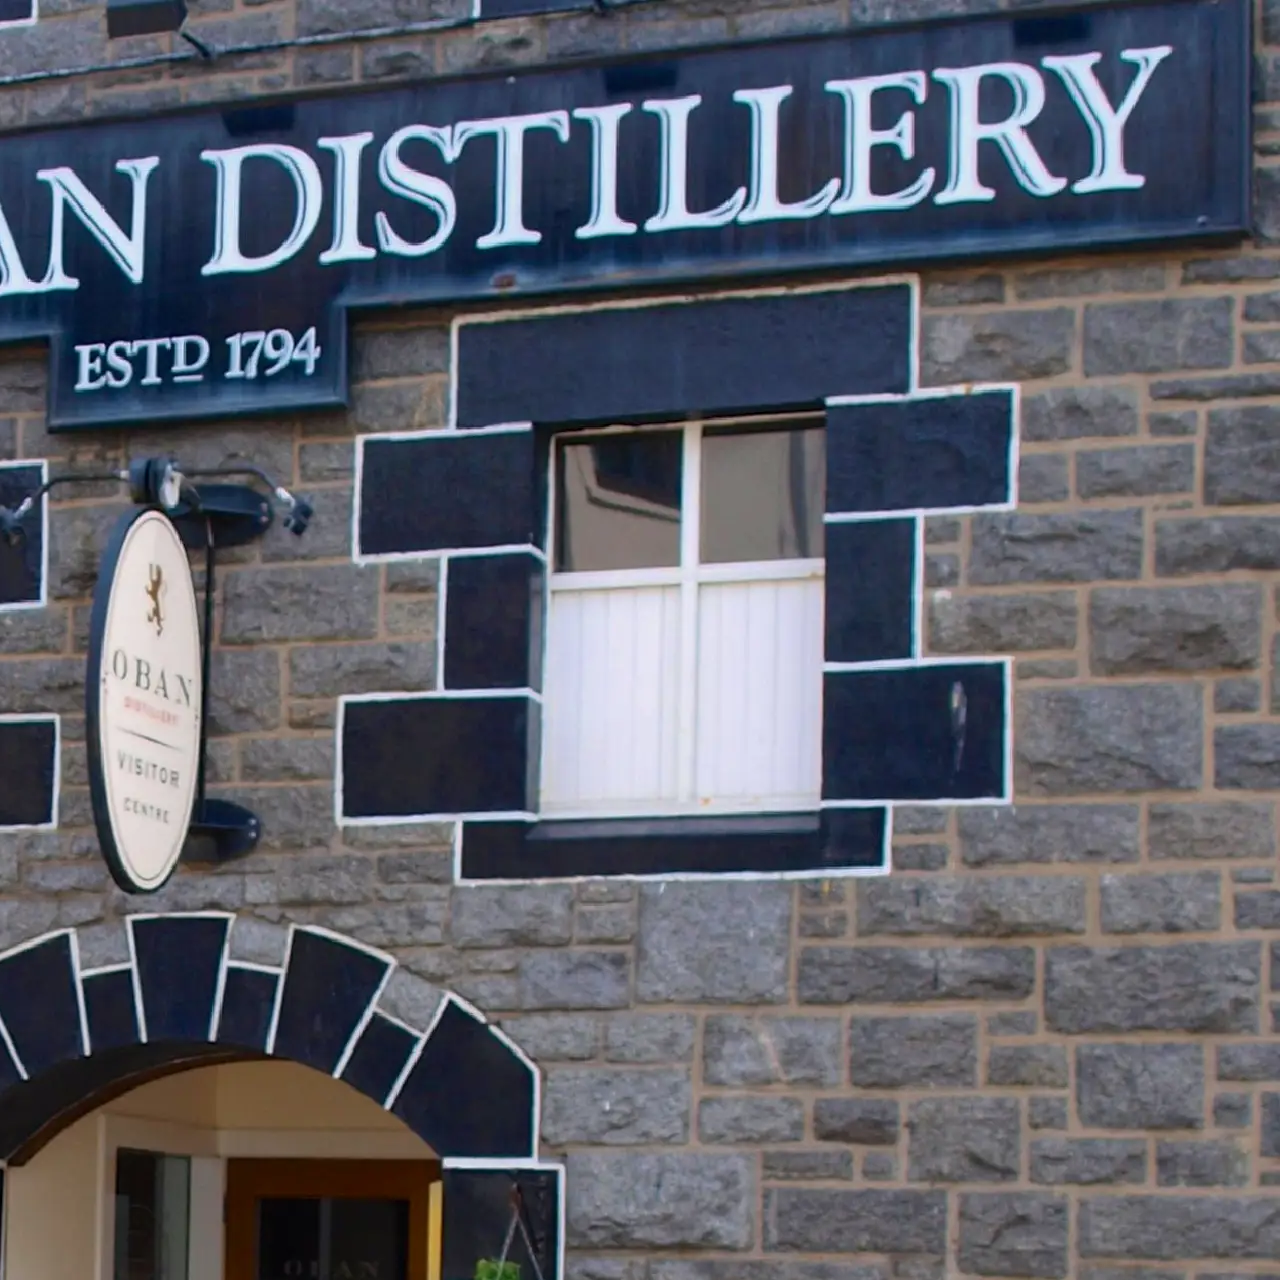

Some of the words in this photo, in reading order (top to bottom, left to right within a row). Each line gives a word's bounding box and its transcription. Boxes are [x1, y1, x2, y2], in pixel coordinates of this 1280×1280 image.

[200, 45, 1174, 278] DISTILLERY
[74, 335, 210, 391] ESTD
[224, 326, 322, 379] 1794
[112, 649, 193, 708] OBAN
[117, 749, 181, 789] VISITOR
[124, 797, 170, 825] CENTRE
